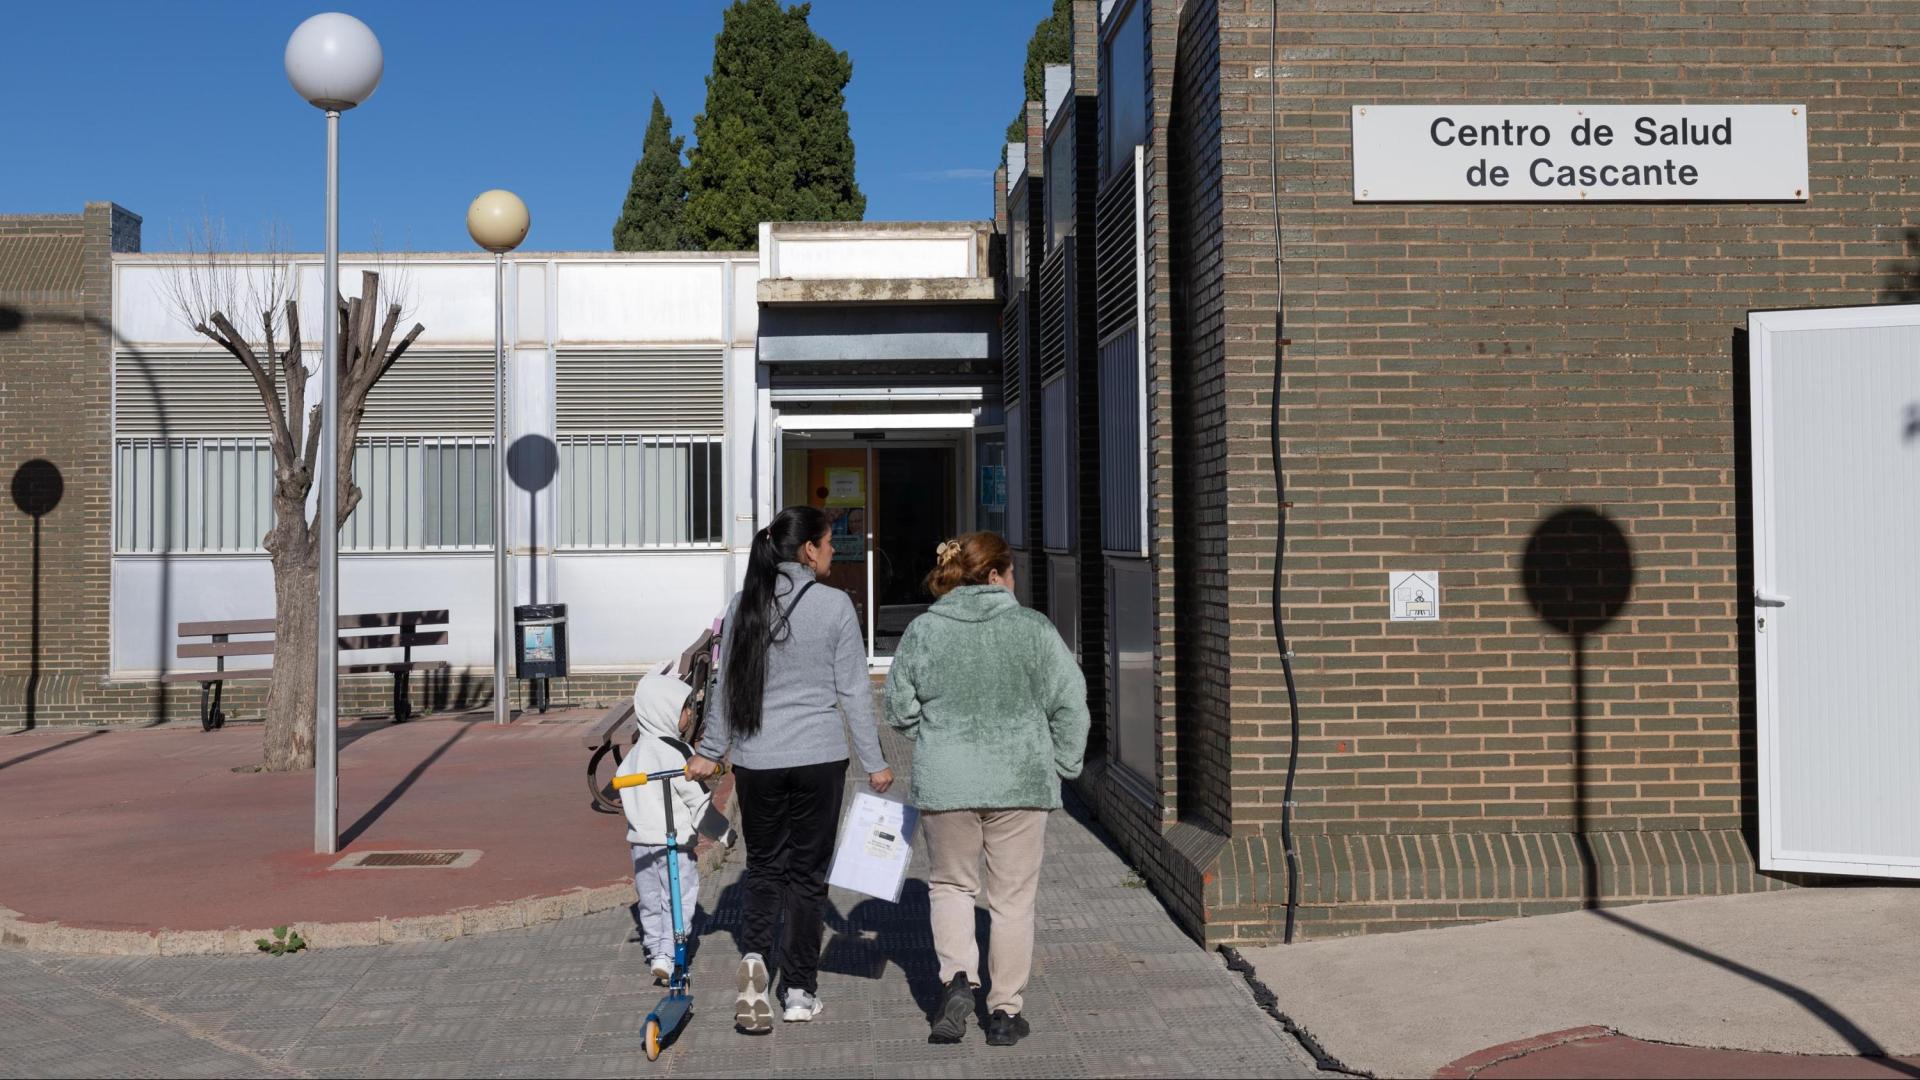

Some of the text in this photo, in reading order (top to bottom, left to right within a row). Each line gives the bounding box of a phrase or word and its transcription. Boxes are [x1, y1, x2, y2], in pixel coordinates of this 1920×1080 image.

[1431, 117, 1731, 146] Centro de Salud
[1467, 158, 1698, 187] de Cascante
